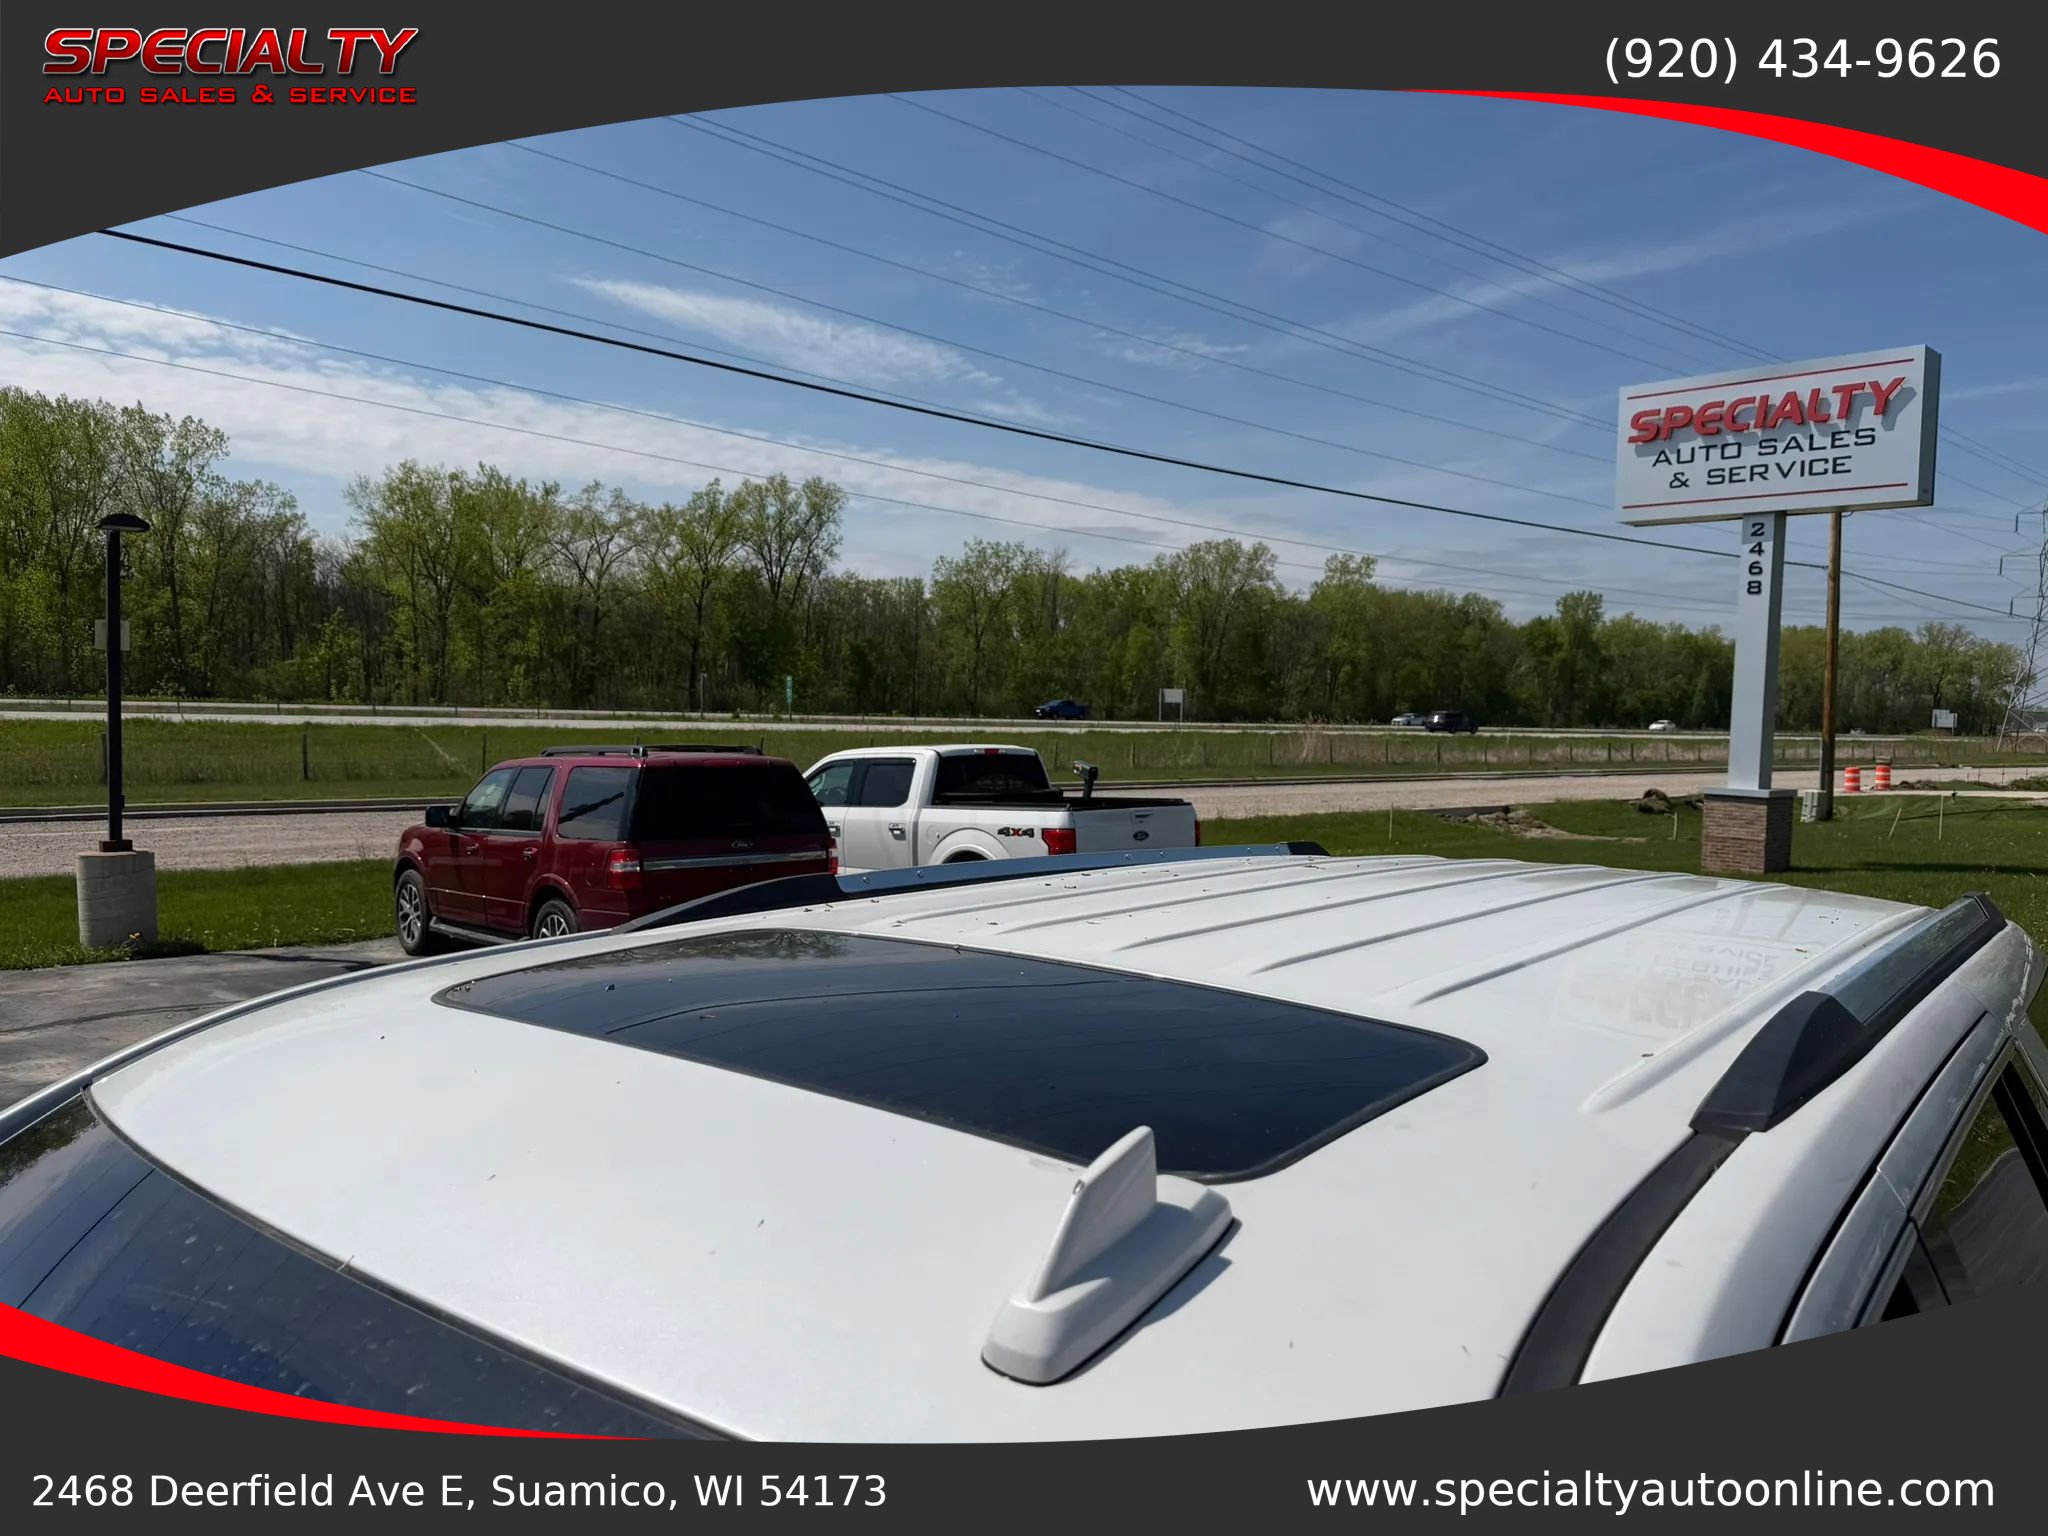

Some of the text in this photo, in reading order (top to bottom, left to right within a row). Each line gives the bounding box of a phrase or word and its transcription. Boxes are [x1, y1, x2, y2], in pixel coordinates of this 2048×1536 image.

[1628, 377, 1905, 443] SPECIALTY
[1652, 427, 1876, 467] AUTO SALES
[1669, 456, 1852, 489] & SERVICE
